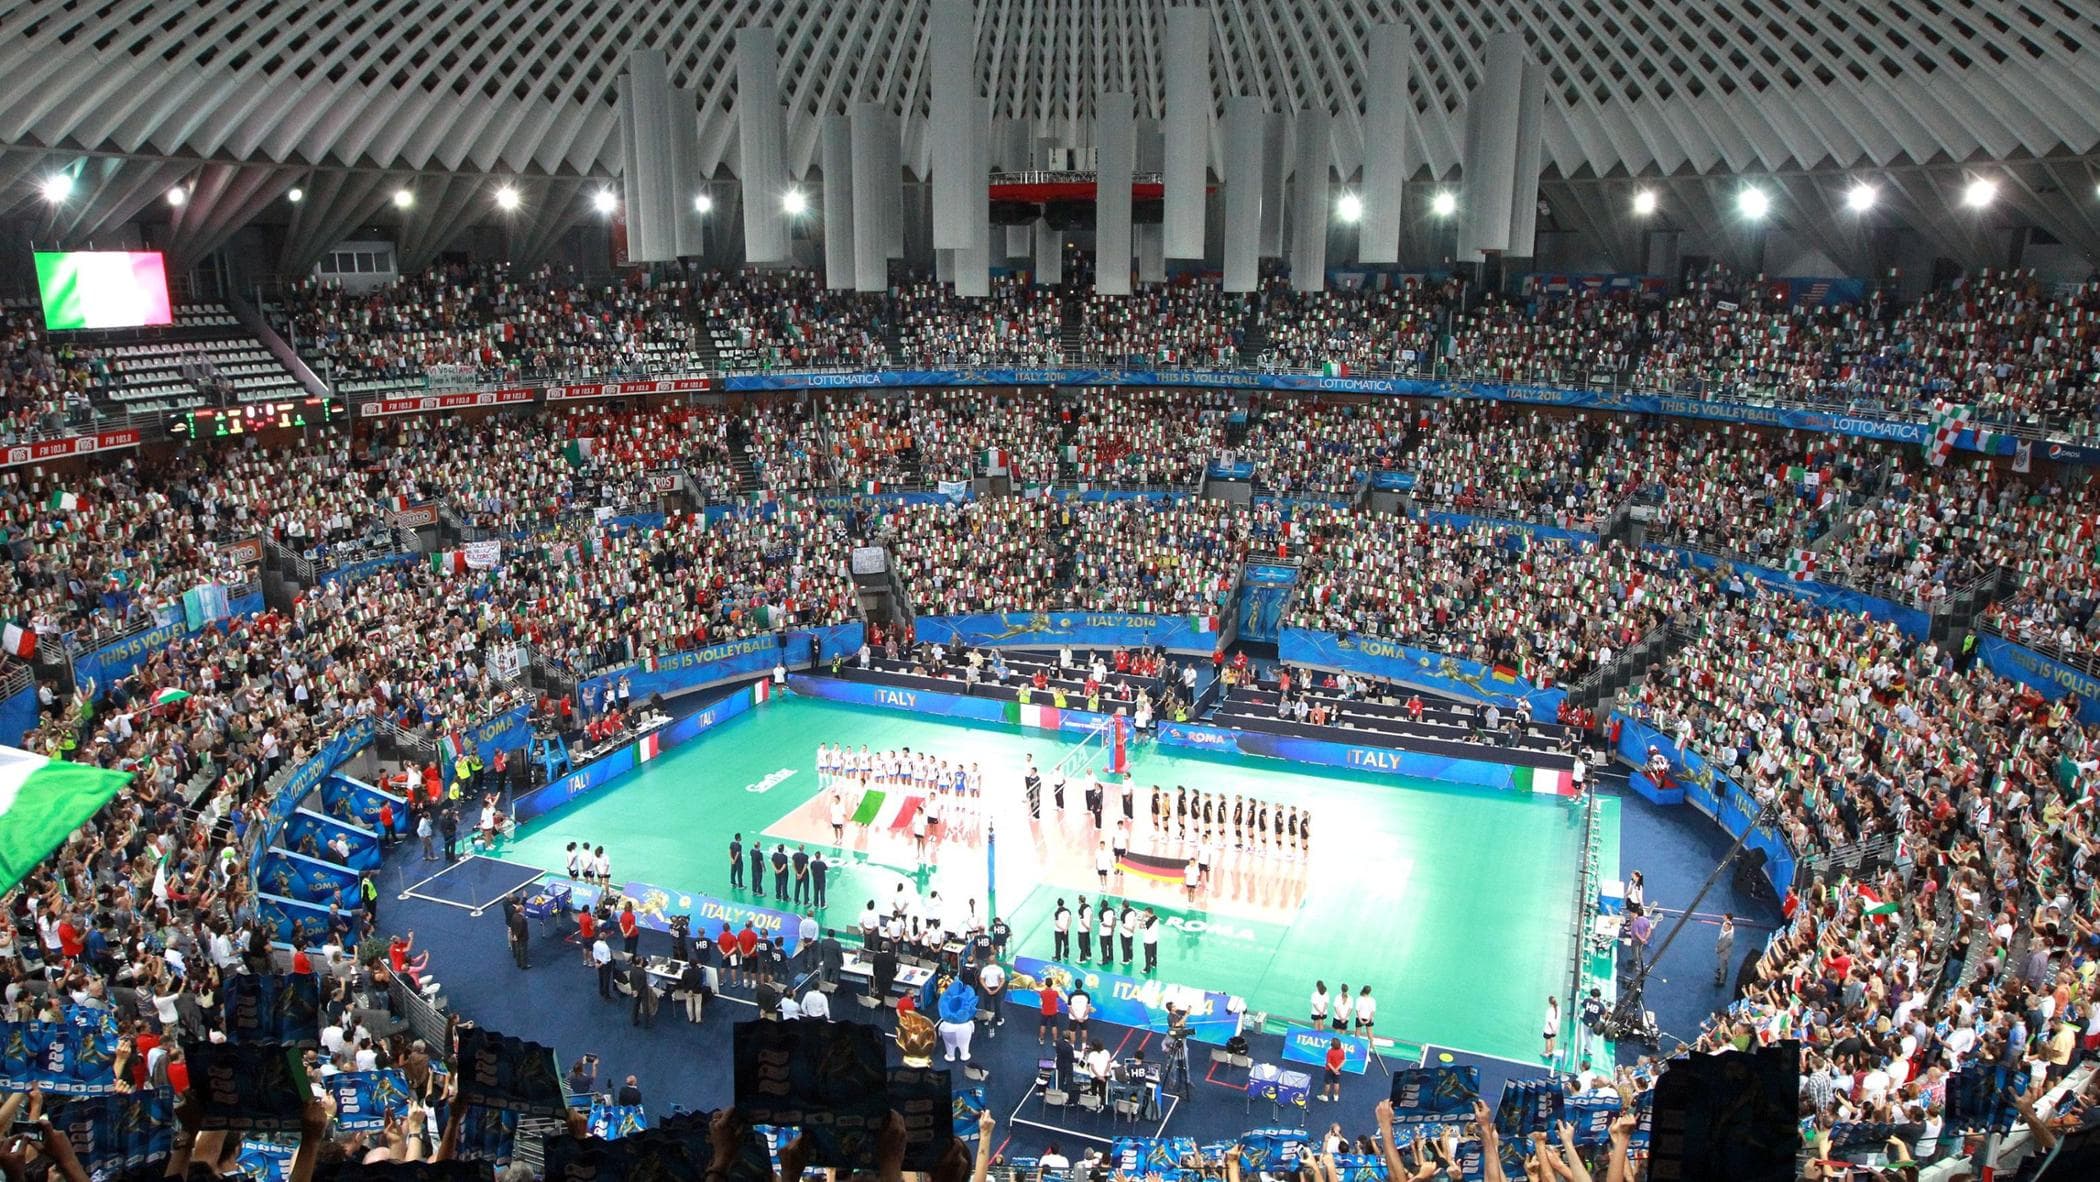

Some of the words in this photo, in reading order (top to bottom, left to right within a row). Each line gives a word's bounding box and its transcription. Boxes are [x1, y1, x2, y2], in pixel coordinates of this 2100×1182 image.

[808, 374, 881, 386] LOTTOMATICA
[1015, 372, 1042, 382] ITALY
[1044, 372, 1066, 382] 2014
[1156, 373, 1179, 383] THIS
[1181, 373, 1190, 383] IS
[1193, 373, 1261, 386] VOLLEYBALL
[627, 385, 636, 393] FM
[1319, 378, 1393, 392] LOTTOMATICA
[572, 388, 583, 396] FM
[1506, 388, 1537, 400] ITALY
[1538, 390, 1562, 400] 2014
[389, 402, 398, 411] FM
[446, 397, 455, 405] FM
[1660, 400, 1685, 412] THIS
[1688, 402, 1699, 414] IS
[1701, 403, 1778, 422] VOLLEYBALL
[1832, 416, 1919, 439] LOTTOMATICA
[105, 437, 115, 446] FM
[40, 446, 49, 457] FM
[2061, 450, 2080, 459] pepsi
[655, 476, 672, 488] RDS
[1086, 615, 1123, 627] ITALY
[1125, 616, 1157, 628] 2014
[98, 648, 128, 668] THIS
[128, 640, 141, 655] IS
[659, 657, 679, 671] HIS
[682, 654, 692, 667] IS
[695, 638, 775, 664] VOLLEYBALL
[1360, 640, 1406, 661] ROMA
[2039, 662, 2051, 678] IS
[874, 688, 916, 707] ITALY
[479, 715, 514, 742] ROMA
[1188, 731, 1225, 744] ROMA
[1347, 749, 1402, 769] ITALY
[567, 771, 591, 794] ITALY
[308, 882, 340, 892] ROMA
[700, 902, 745, 923] ITALY
[746, 911, 782, 931] 2014
[993, 925, 1006, 936] HB
[695, 940, 708, 950] HB
[757, 942, 768, 952] HB
[977, 937, 990, 948] HB
[1586, 1002, 1600, 1015] HB
[1296, 1034, 1327, 1050] ITALY
[1131, 1068, 1145, 1078] HB
